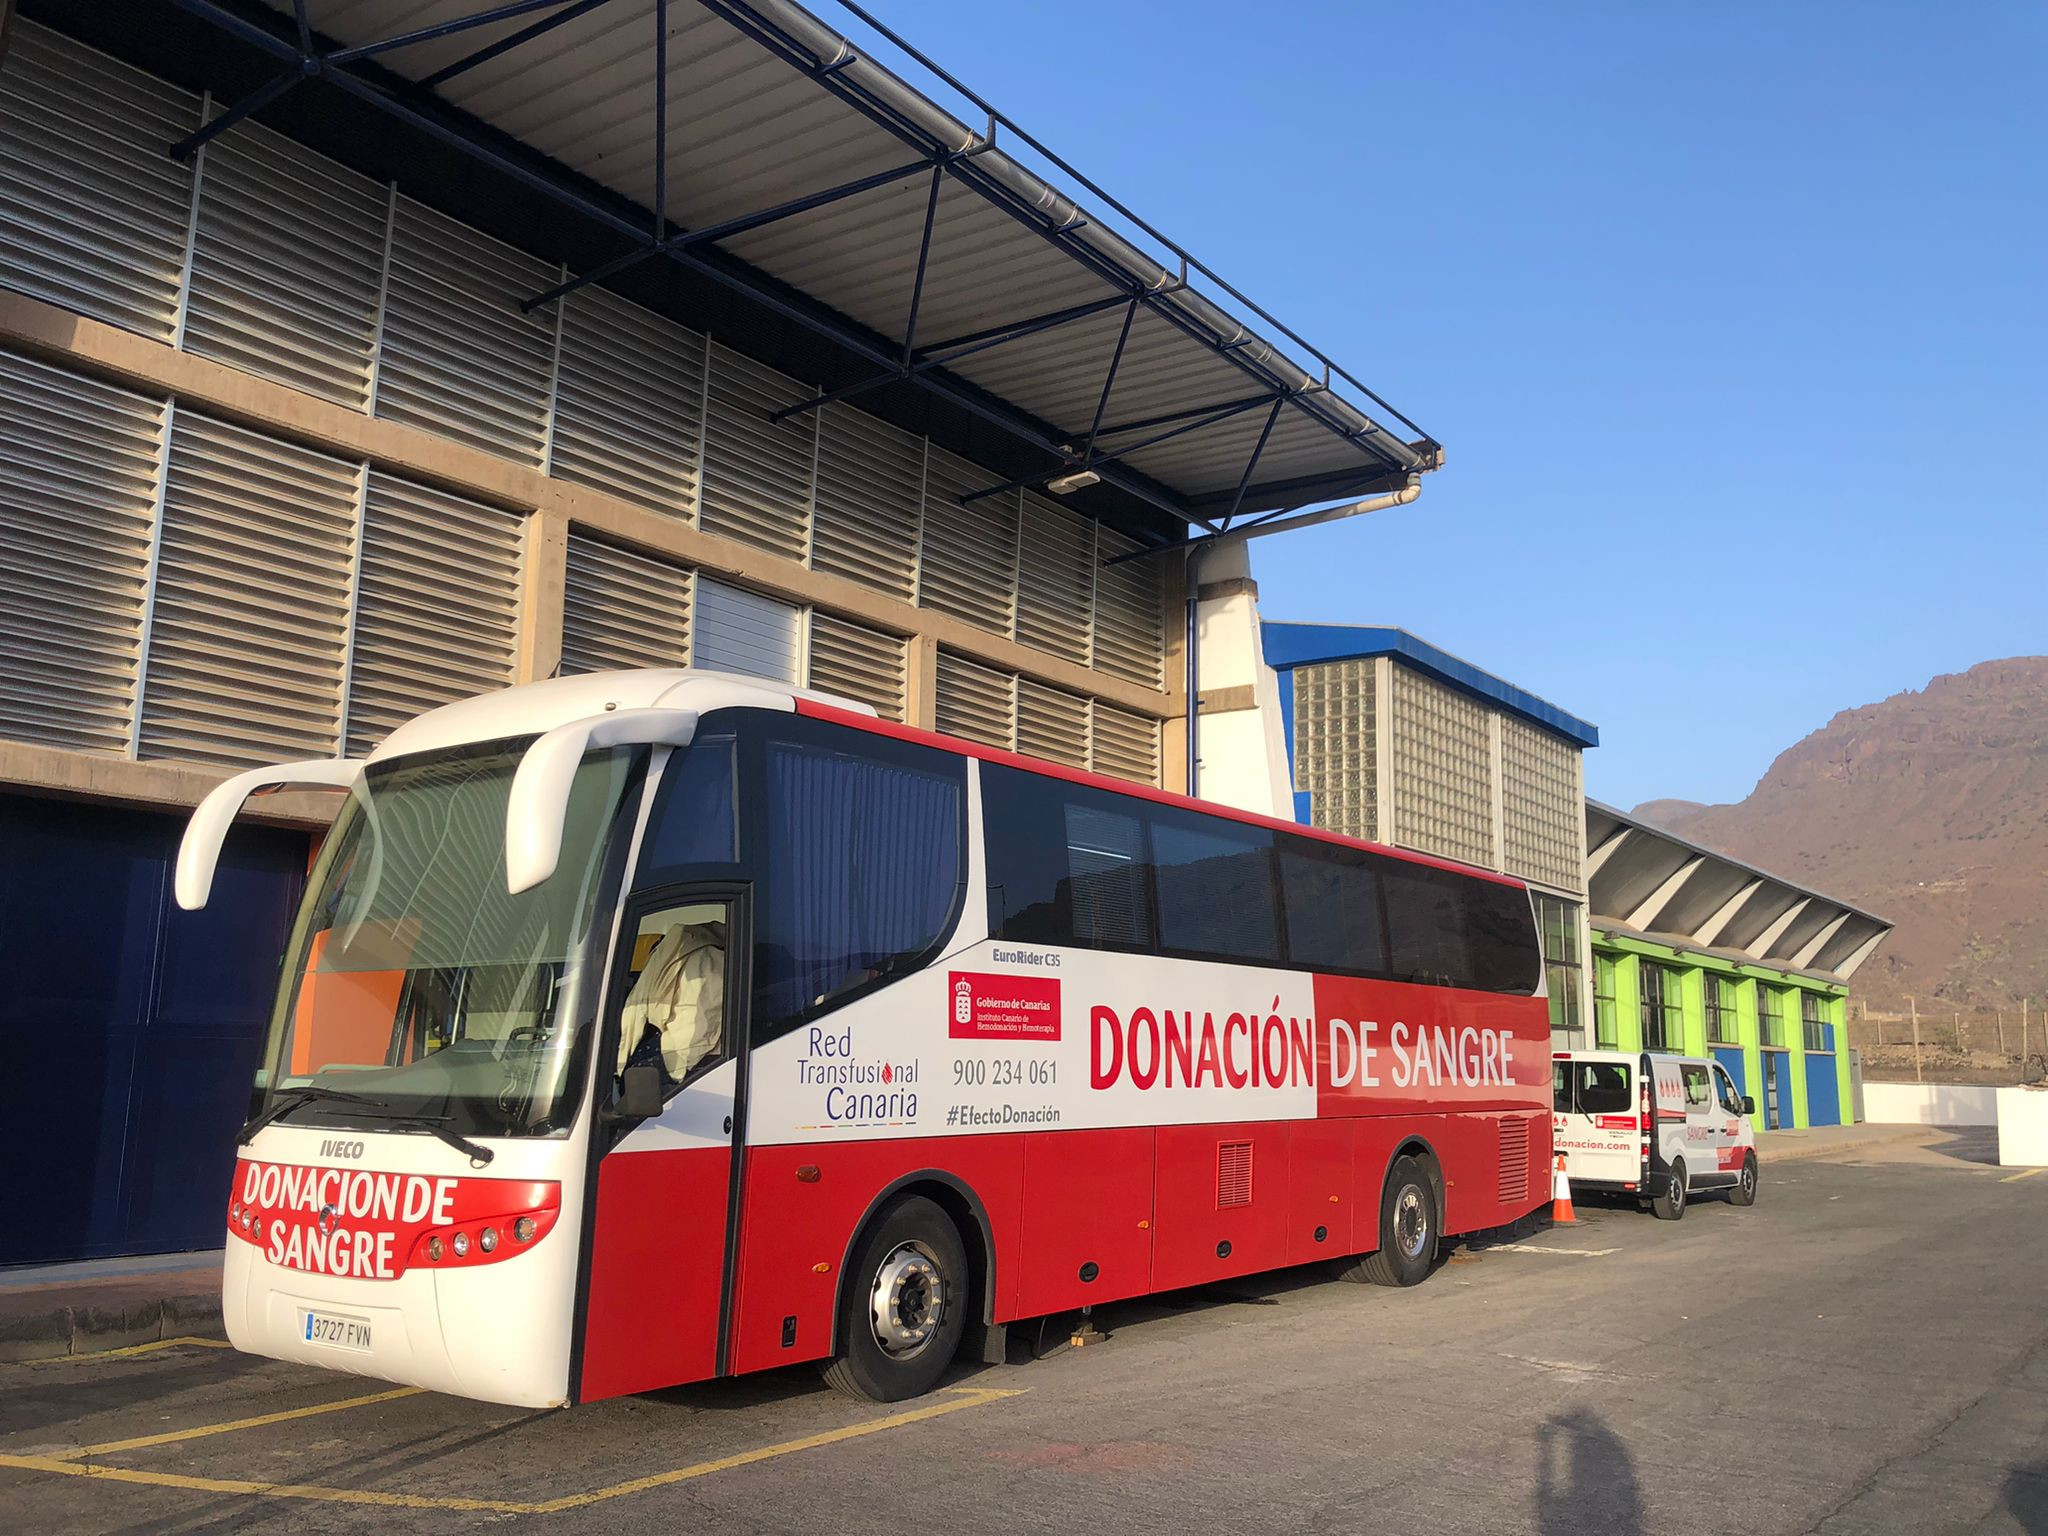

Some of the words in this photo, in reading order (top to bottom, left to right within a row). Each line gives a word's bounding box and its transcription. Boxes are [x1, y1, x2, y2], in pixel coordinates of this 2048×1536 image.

[992, 948, 1044, 966] EuroRider
[1045, 953, 1061, 967] C35
[976, 997, 1010, 1009] Gobierno
[1011, 998, 1020, 1010] de
[1020, 1000, 1051, 1011] Canarias
[809, 1026, 851, 1058] Red
[1090, 994, 1314, 1091] DONACIÓN
[1329, 1018, 1380, 1088] DE
[1390, 1021, 1516, 1088] SANGRE
[953, 1059, 986, 1086] 900
[992, 1059, 1023, 1085] 234
[1029, 1059, 1057, 1085] 061
[826, 1086, 918, 1121] Canaria
[946, 1104, 1061, 1126] #EfectoDonación
[319, 1139, 365, 1160] IVECO
[243, 1162, 401, 1221] DONACION
[401, 1176, 458, 1225] DE
[267, 1219, 396, 1279] SANGRE
[314, 1318, 345, 1341] 3727
[347, 1323, 371, 1347] FVN
